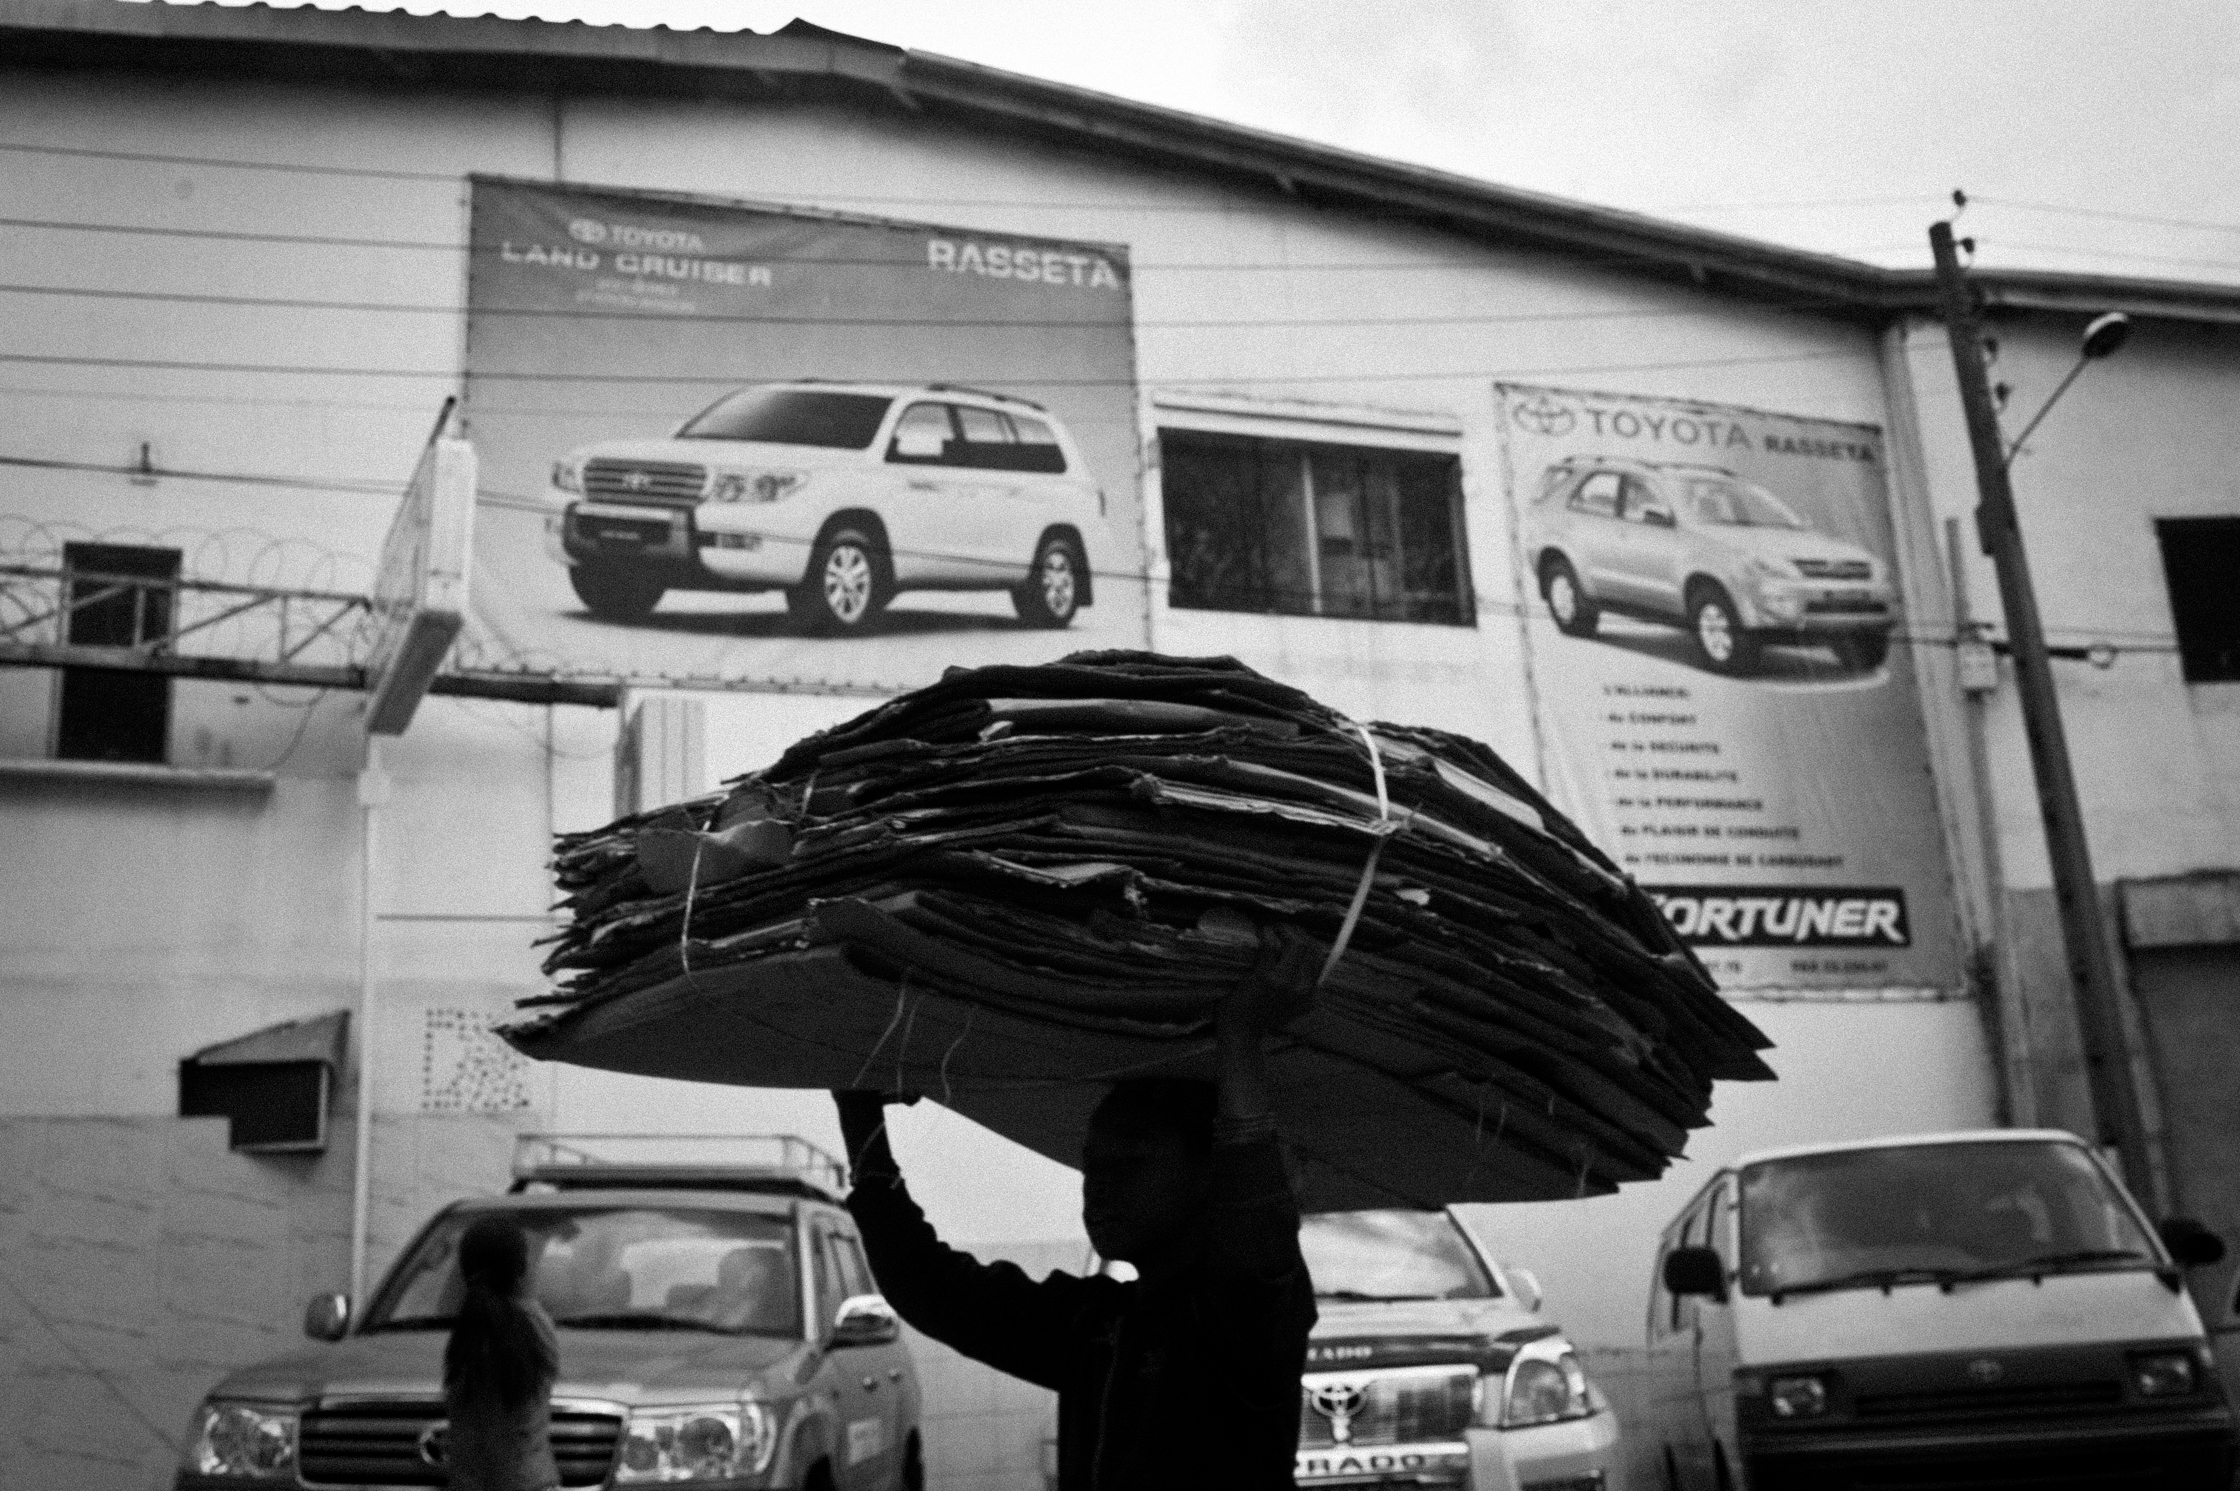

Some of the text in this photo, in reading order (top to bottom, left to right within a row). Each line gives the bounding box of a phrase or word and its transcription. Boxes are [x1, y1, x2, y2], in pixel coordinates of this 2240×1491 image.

[611, 224, 703, 251] TOYOTA
[501, 241, 600, 270] LAND
[615, 253, 773, 287] CRUISER
[928, 239, 1118, 290] RASSETA
[1586, 408, 1877, 463] TOYOTA RASSETA
[1629, 713, 1697, 726] CONFORT
[1306, 1347, 1373, 1361] RADO
[1306, 1454, 1425, 1471] RADO
